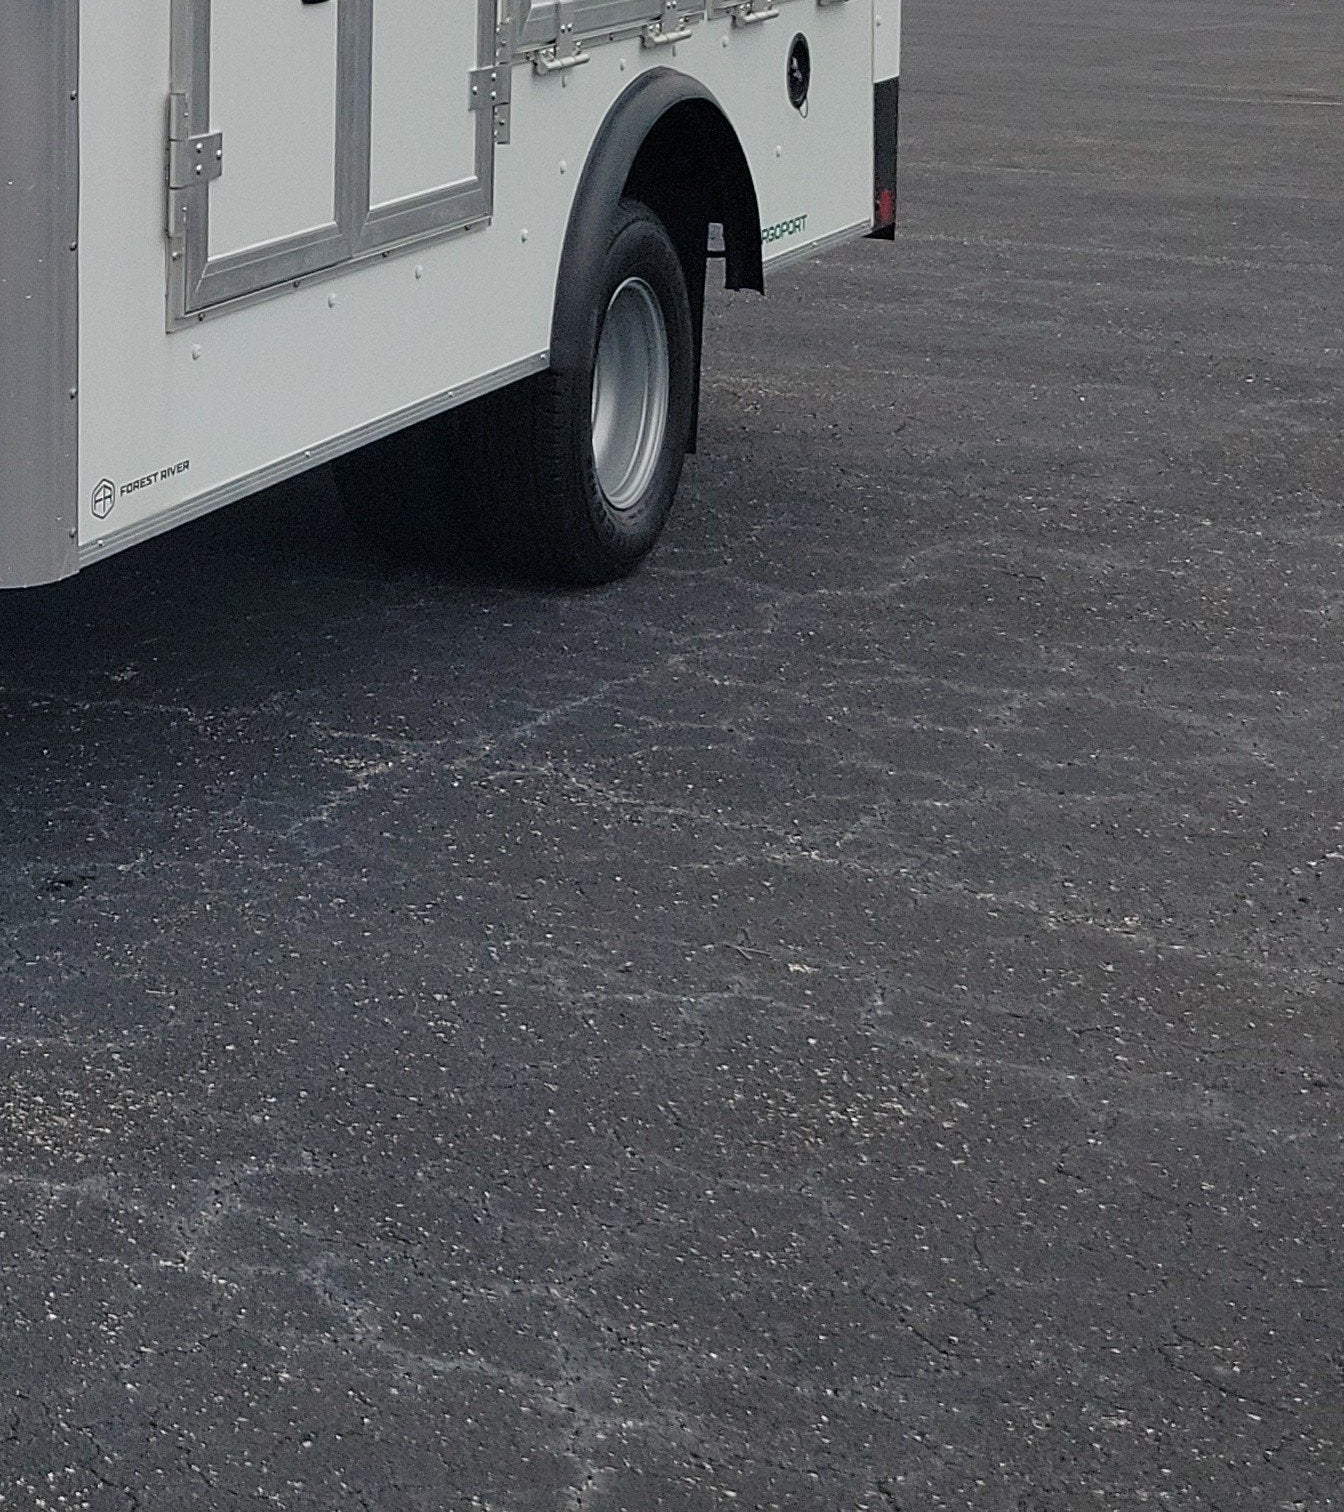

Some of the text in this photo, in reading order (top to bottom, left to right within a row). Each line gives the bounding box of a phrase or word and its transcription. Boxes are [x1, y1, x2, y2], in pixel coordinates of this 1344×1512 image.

[761, 214, 808, 243] RGOPORT
[120, 460, 190, 497] FOREST RIVER
